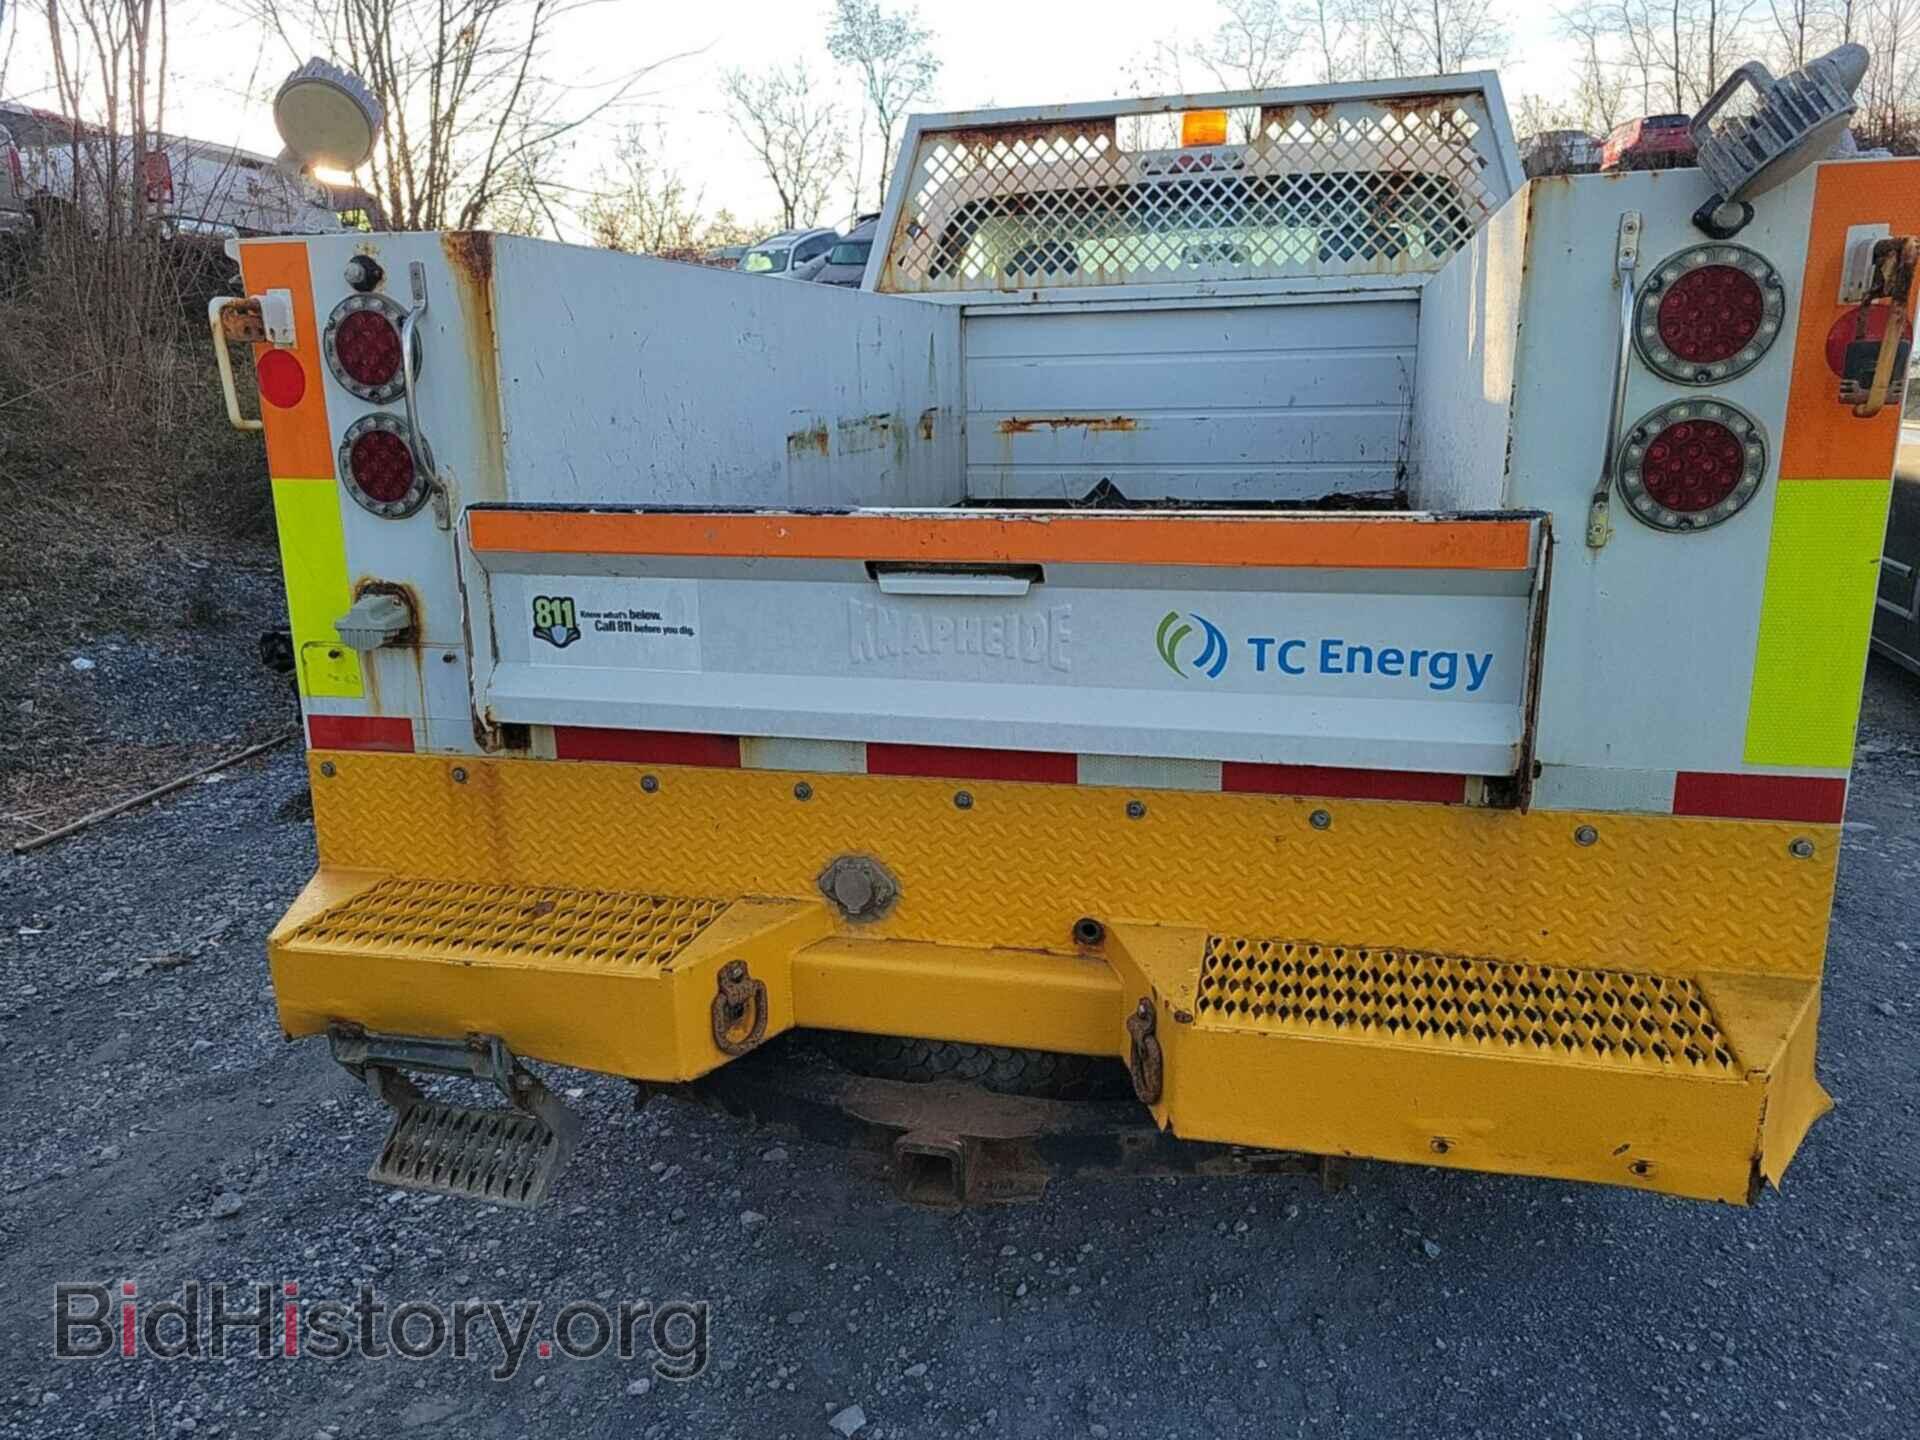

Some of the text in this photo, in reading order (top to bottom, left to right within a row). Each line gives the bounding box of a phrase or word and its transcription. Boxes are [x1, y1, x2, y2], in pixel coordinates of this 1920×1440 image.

[534, 597, 574, 629] 811
[629, 609, 662, 620] below.
[595, 620, 695, 637] Call 811 before you dig.
[1247, 637, 1494, 692] TC Energy
